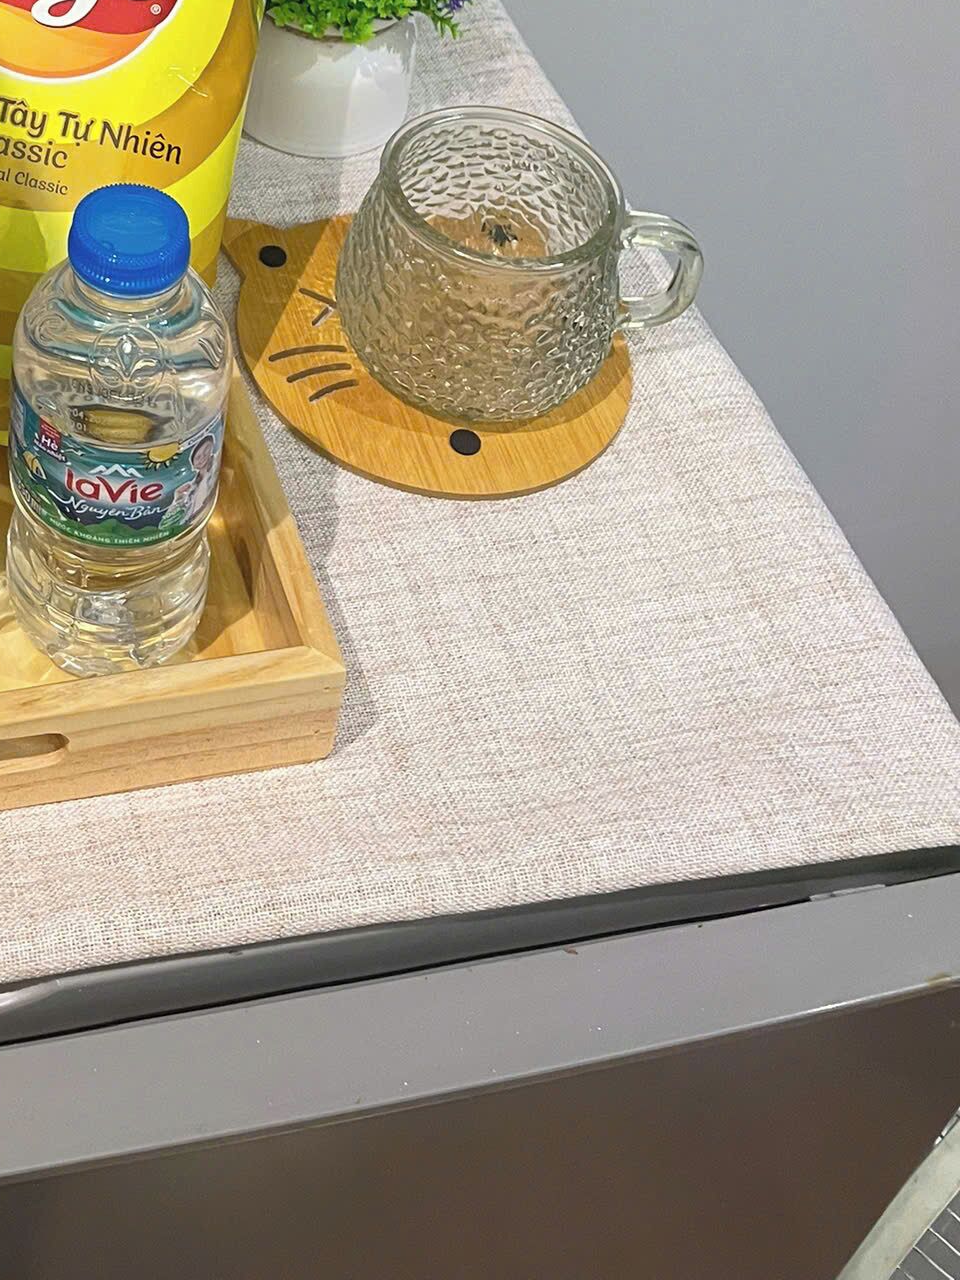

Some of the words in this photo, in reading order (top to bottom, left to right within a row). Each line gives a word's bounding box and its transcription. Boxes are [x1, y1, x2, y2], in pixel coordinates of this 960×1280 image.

[58, 113, 95, 146] Tự
[100, 120, 183, 165] Nhiên
[14, 171, 69, 196] Classic
